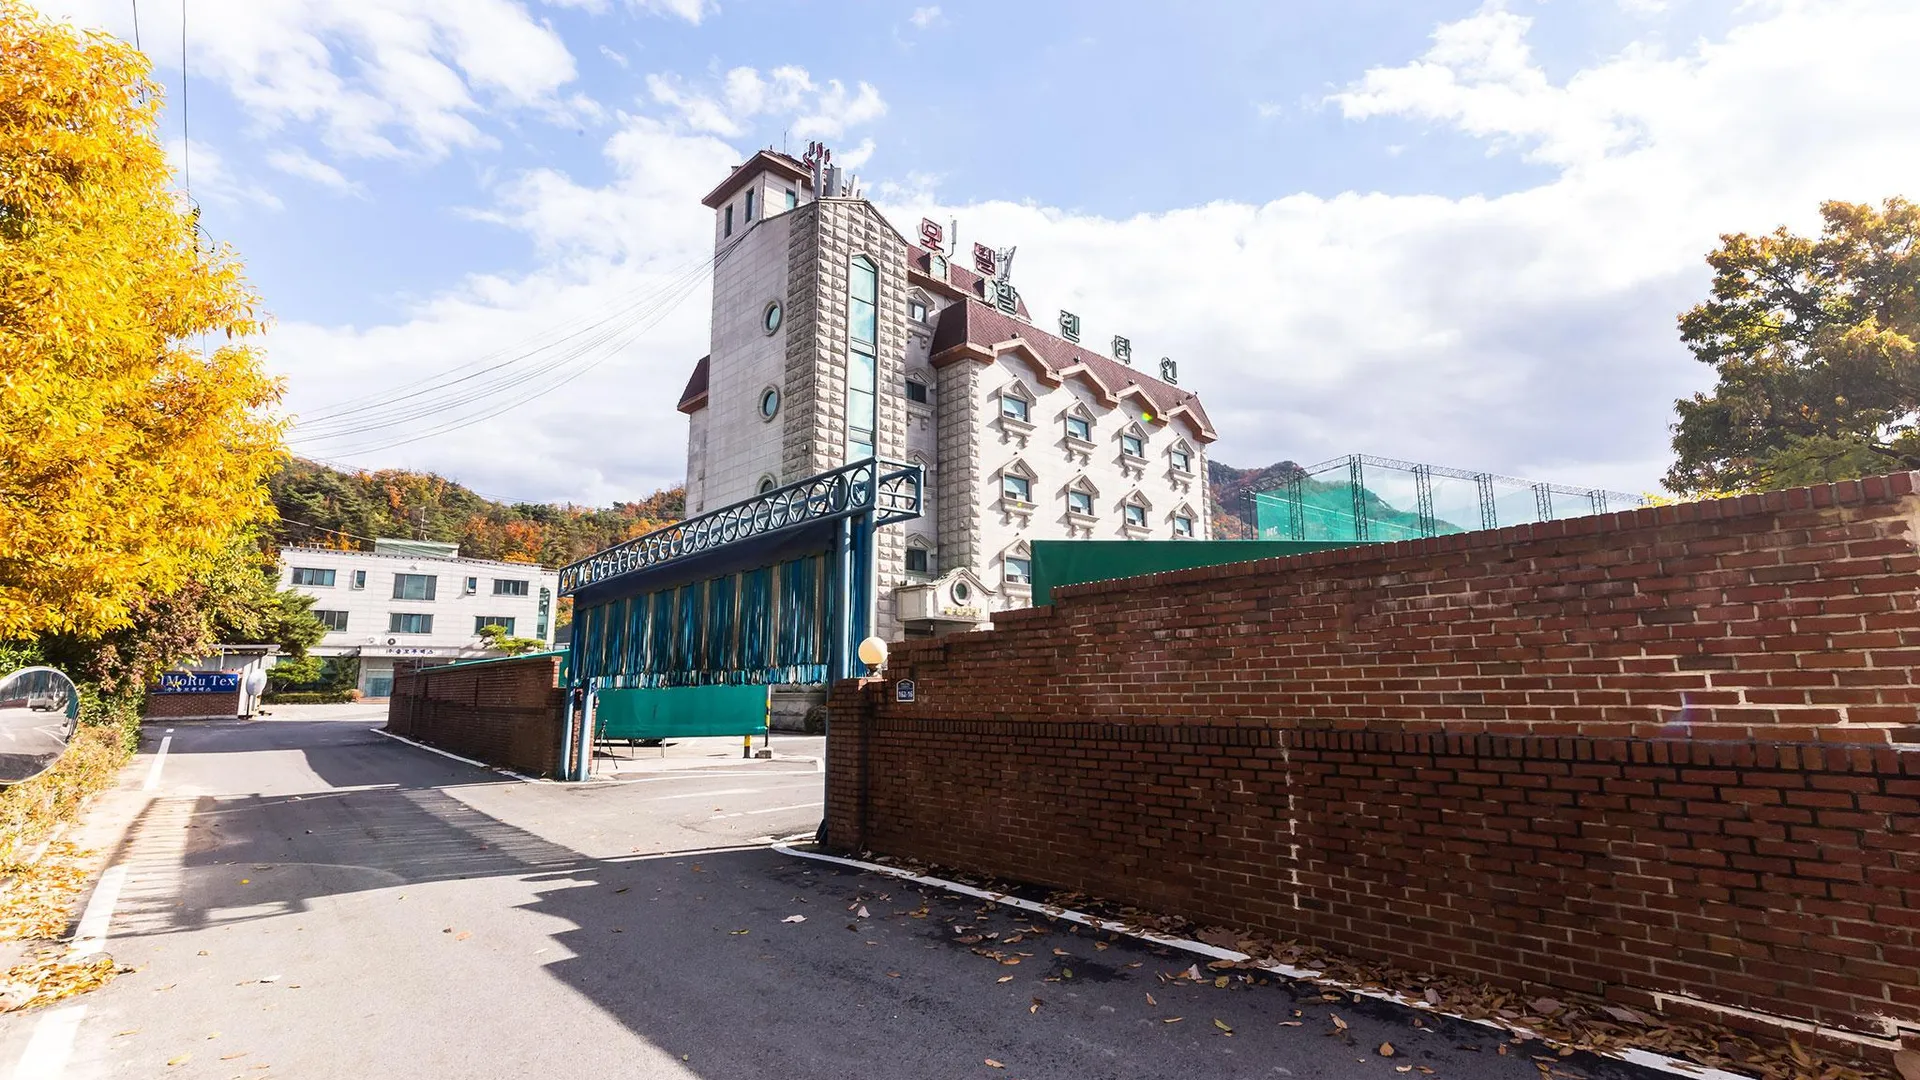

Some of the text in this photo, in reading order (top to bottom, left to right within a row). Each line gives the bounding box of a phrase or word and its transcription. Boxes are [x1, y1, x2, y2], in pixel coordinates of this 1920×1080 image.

[919, 216, 1178, 385] 모텔 발렌타인
[209, 675, 236, 687] Tex
